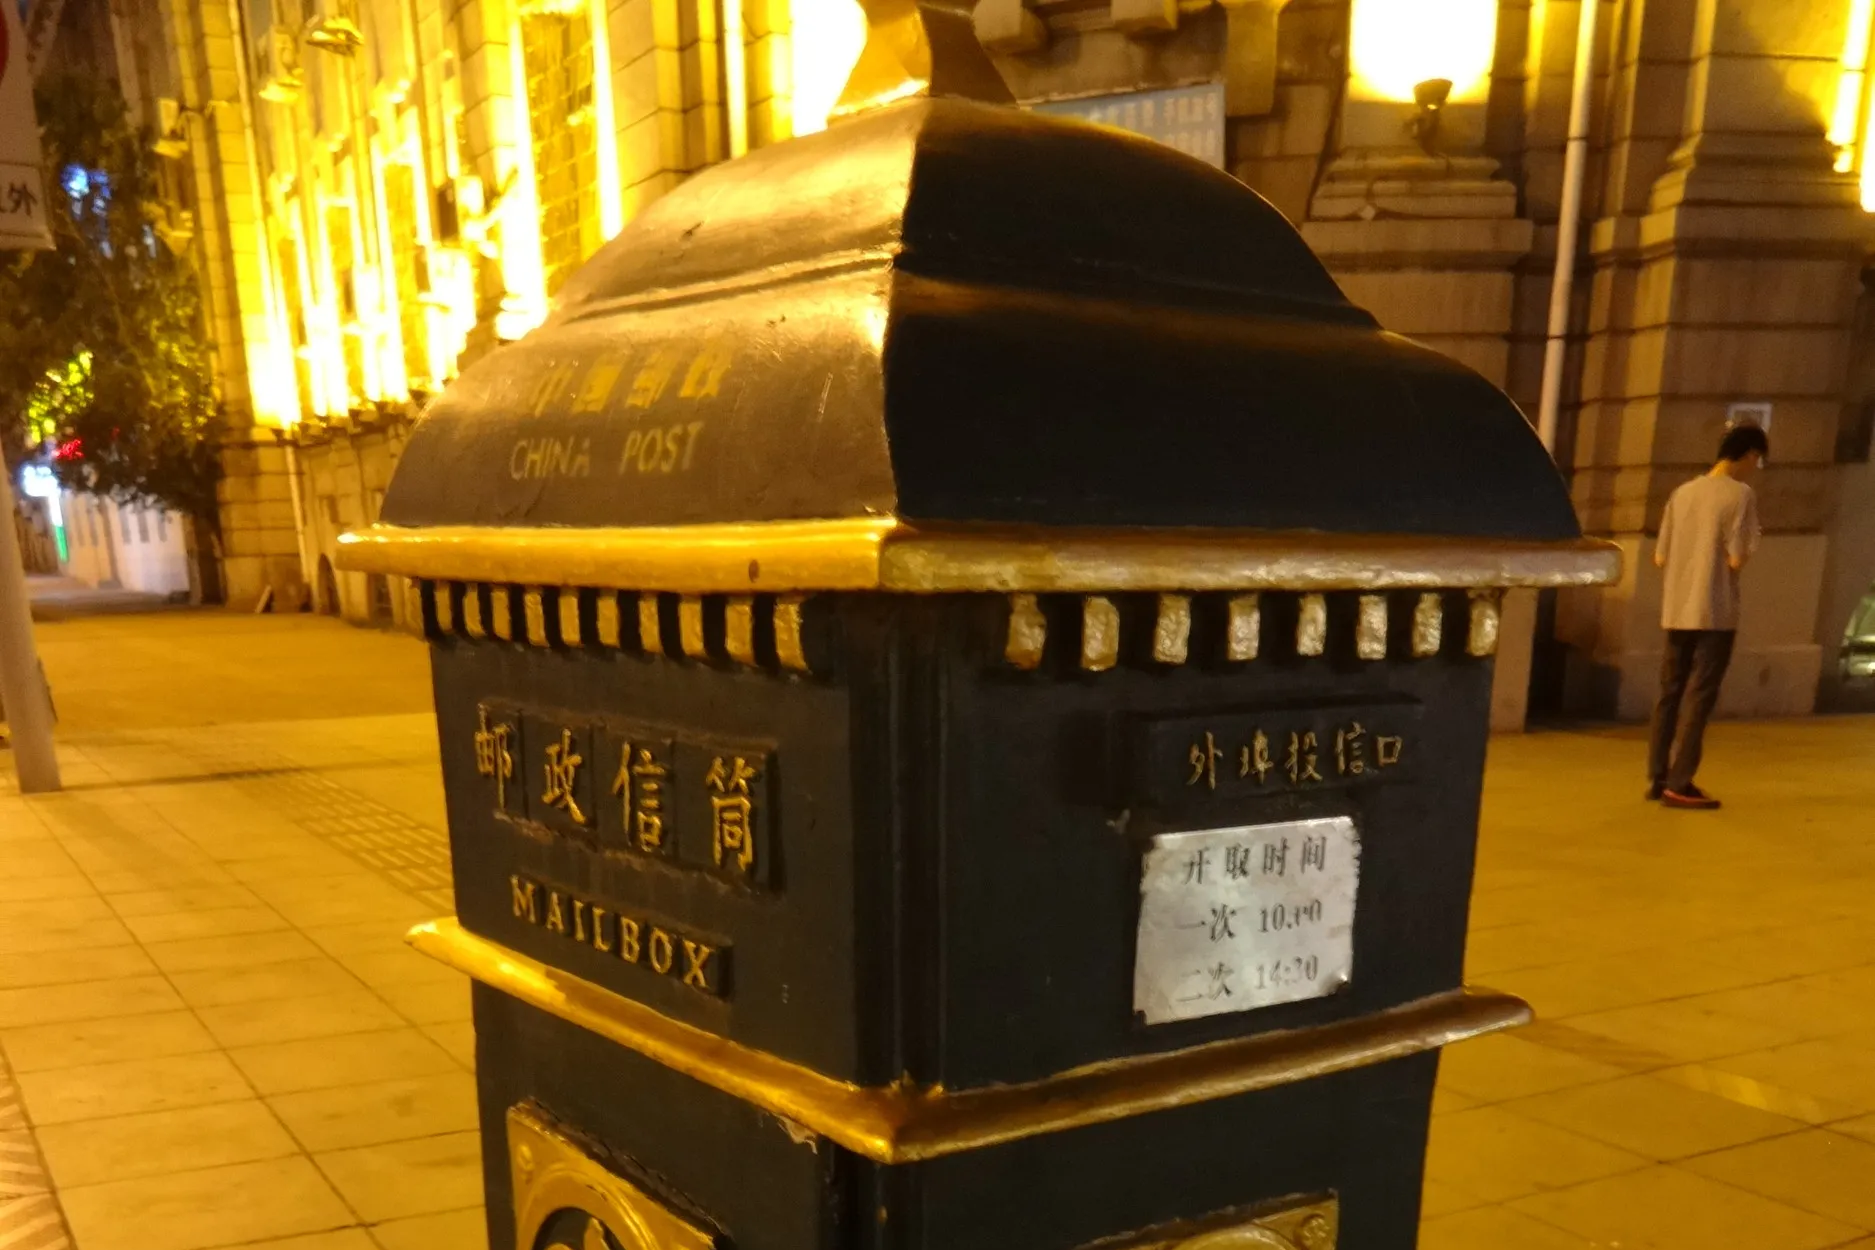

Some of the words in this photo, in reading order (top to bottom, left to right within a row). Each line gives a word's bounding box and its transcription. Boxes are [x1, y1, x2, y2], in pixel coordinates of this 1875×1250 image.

[0, 182, 38, 218] 外
[509, 437, 590, 481] CHINA
[619, 420, 705, 476] POST
[474, 703, 755, 872] 邮政信筒
[1187, 721, 1402, 790] 外埠投信口
[510, 875, 715, 988] MAILBOX
